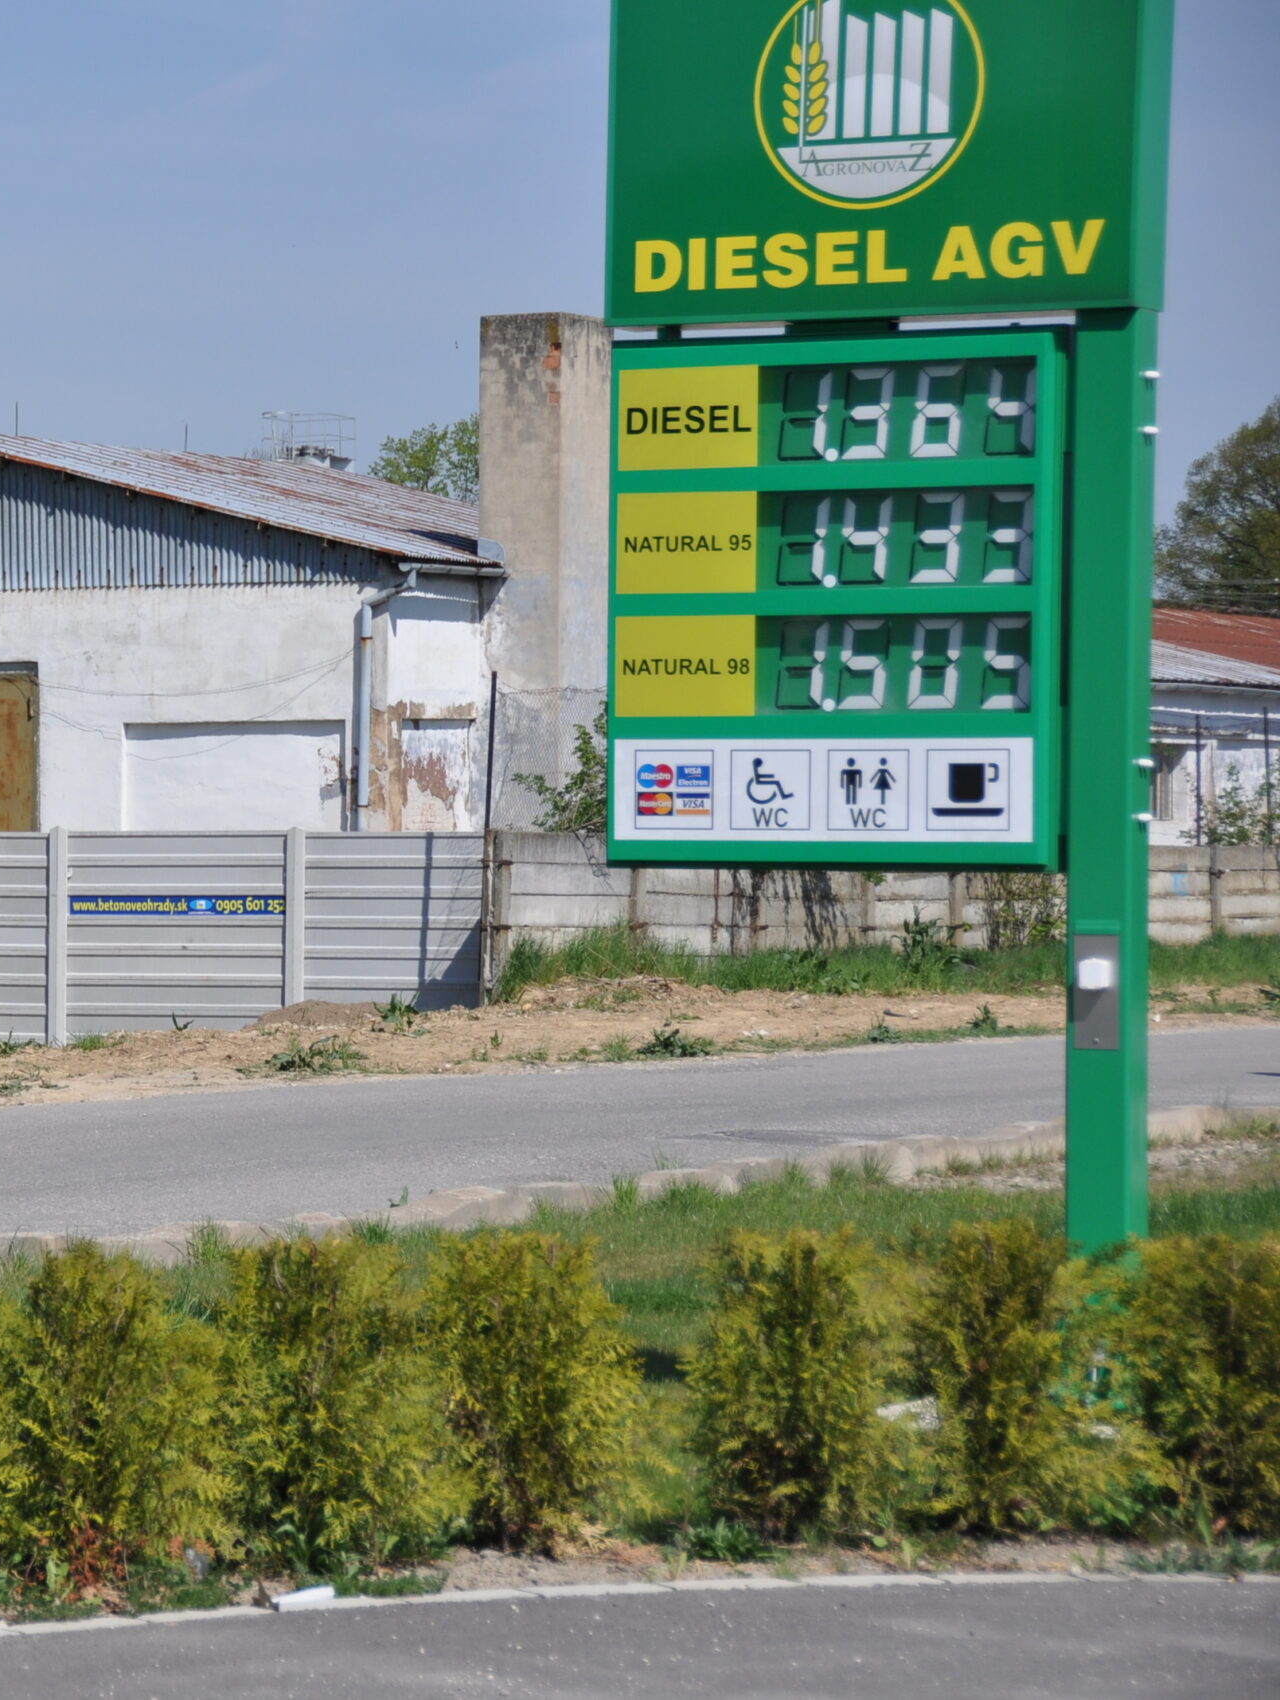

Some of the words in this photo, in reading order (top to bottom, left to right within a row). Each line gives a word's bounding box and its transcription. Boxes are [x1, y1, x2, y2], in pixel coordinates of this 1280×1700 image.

[633, 229, 908, 293] DIESEL
[931, 218, 1105, 281] AGV
[626, 405, 752, 435] DIESEL
[623, 536, 723, 553] NATURAL
[728, 534, 752, 552] 95
[622, 658, 721, 676] NATURAL
[726, 657, 750, 676] 98
[640, 772, 672, 780] Maestro
[684, 767, 702, 775] VISA
[682, 799, 705, 809] VISA
[753, 808, 789, 828] WC
[850, 808, 887, 828] WC
[73, 898, 188, 915] www.betonoveohrady.sk
[216, 899, 243, 914] 0905
[246, 897, 265, 911] 601
